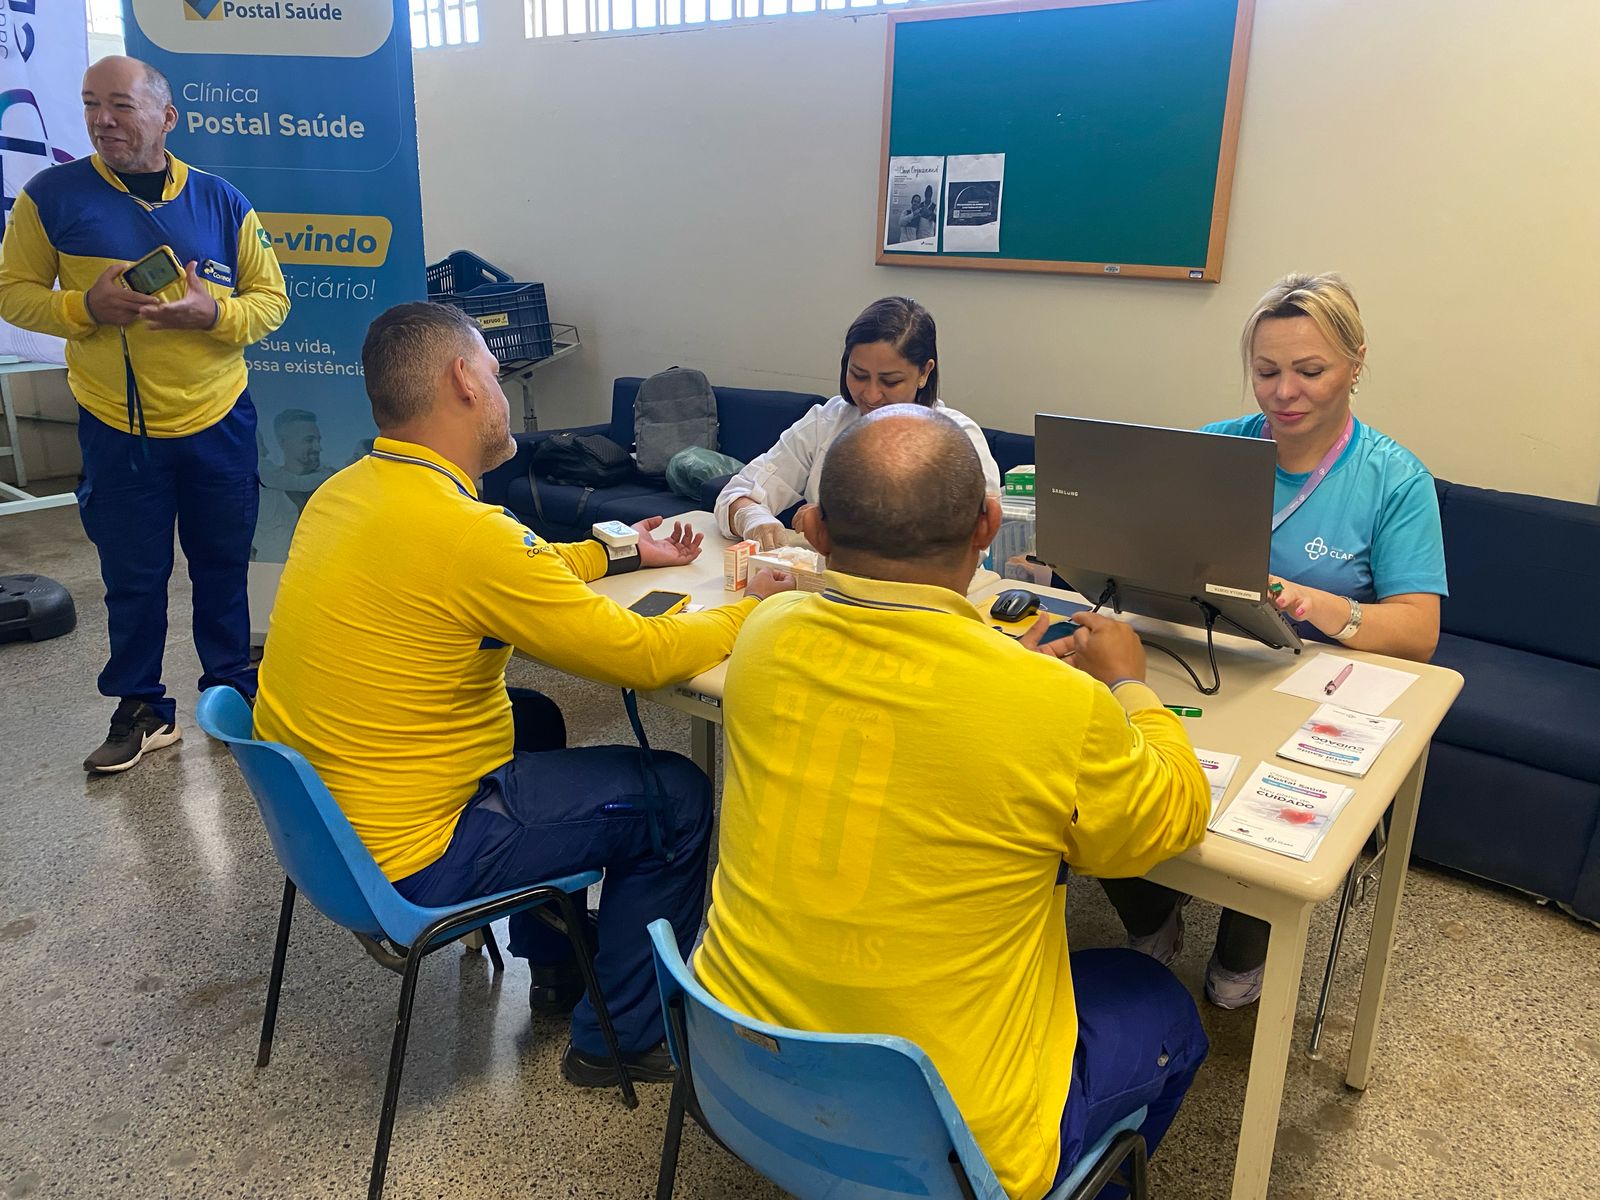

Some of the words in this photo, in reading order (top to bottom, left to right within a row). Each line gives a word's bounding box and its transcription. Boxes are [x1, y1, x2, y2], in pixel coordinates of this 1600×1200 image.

[224, 2, 280, 18] Postal
[285, 3, 342, 20] Saúde
[183, 83, 259, 103] Clínica
[186, 112, 270, 135] Postal
[279, 113, 365, 138] Saúde
[260, 338, 290, 352] Sua
[295, 339, 336, 356] vida,
[1311, 735, 1365, 751] CUIDADO
[1268, 774, 1297, 786] Postal
[1256, 790, 1315, 809] CUIDADO
